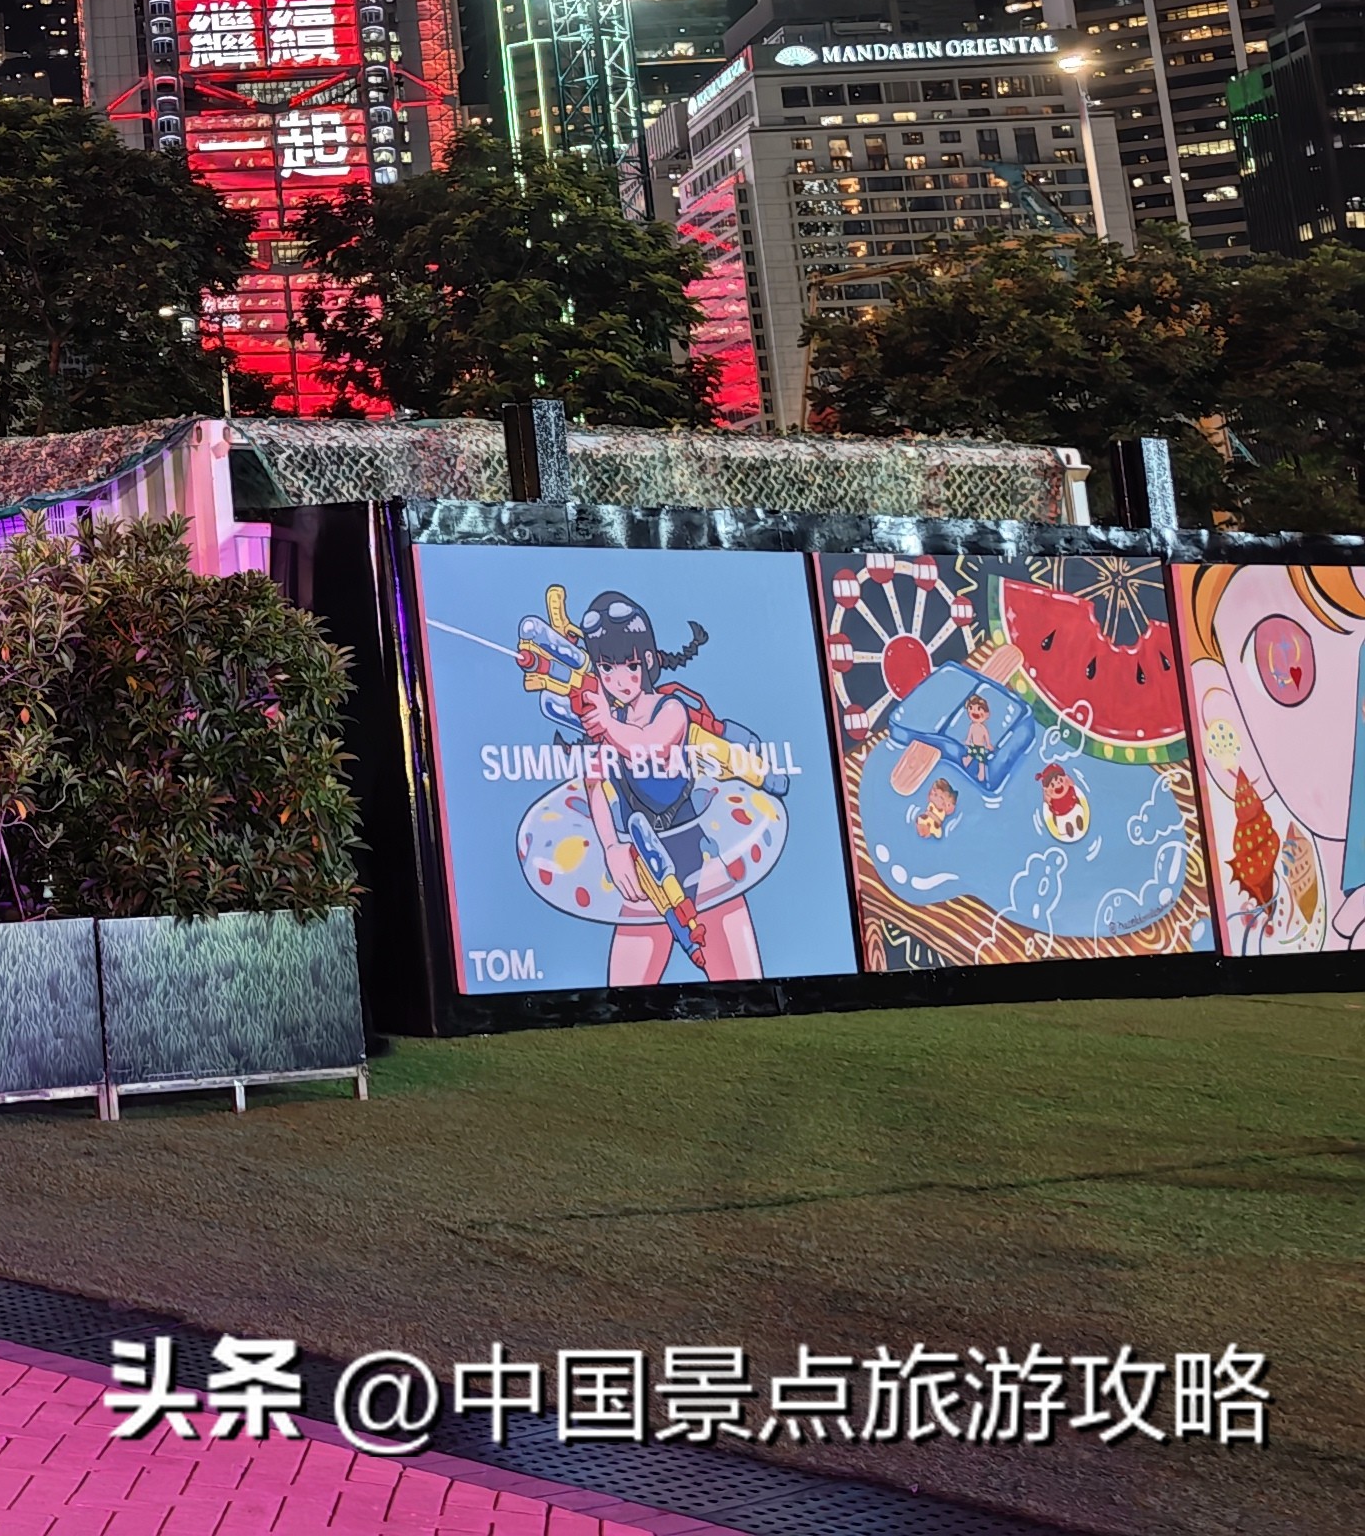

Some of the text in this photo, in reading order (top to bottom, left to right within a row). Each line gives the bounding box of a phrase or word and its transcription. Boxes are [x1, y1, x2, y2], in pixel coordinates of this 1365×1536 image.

[822, 34, 1059, 64] MANDARIN ORIENTAL
[198, 110, 352, 179] 一起
[480, 741, 803, 781] SUMMER BEATS DULL
[468, 948, 544, 982] TOM.
